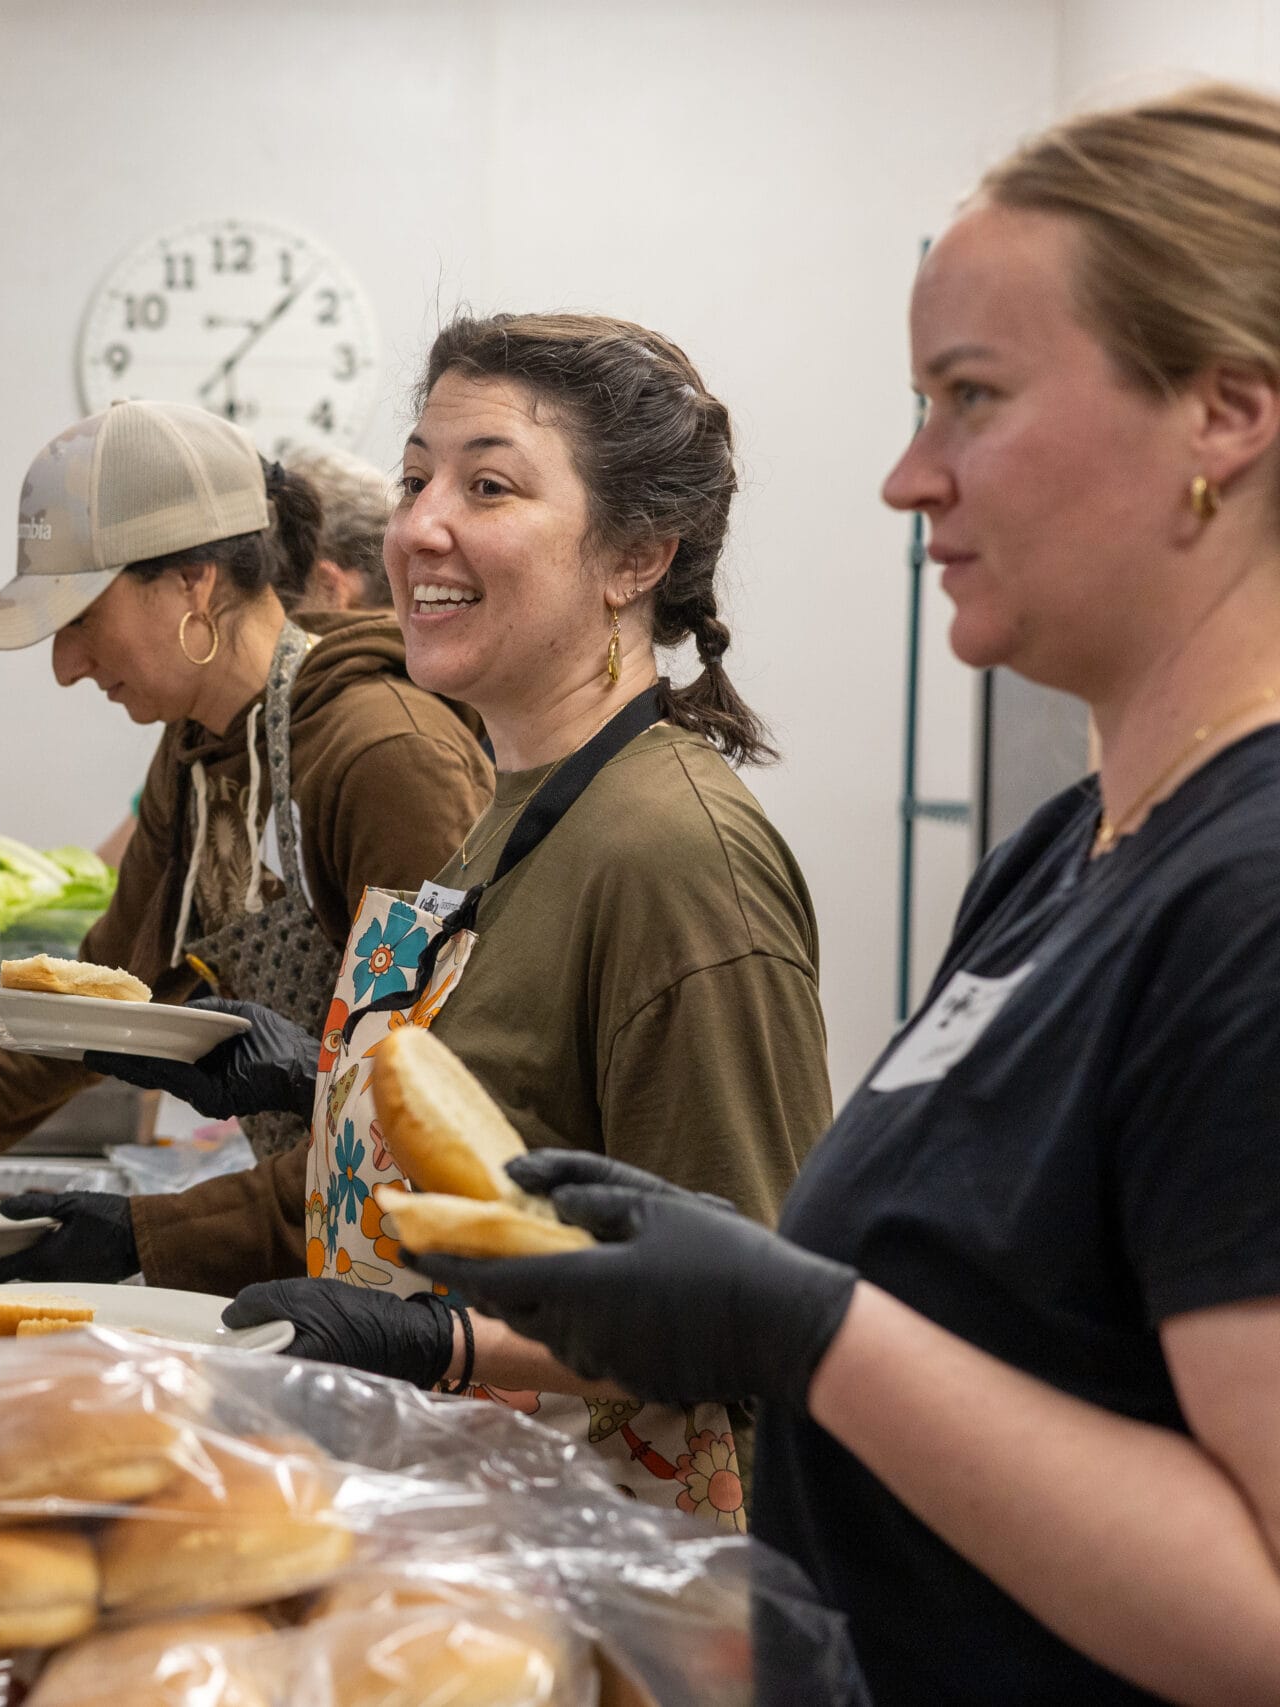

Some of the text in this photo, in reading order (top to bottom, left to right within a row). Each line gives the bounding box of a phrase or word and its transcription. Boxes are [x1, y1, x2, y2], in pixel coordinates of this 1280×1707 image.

[163, 254, 196, 290] 11
[211, 236, 255, 273] 12
[278, 250, 293, 285] 1
[124, 294, 168, 330] 10
[315, 289, 340, 324] 2
[104, 343, 132, 375] 9
[333, 345, 357, 381] 3
[309, 398, 334, 432] 4
